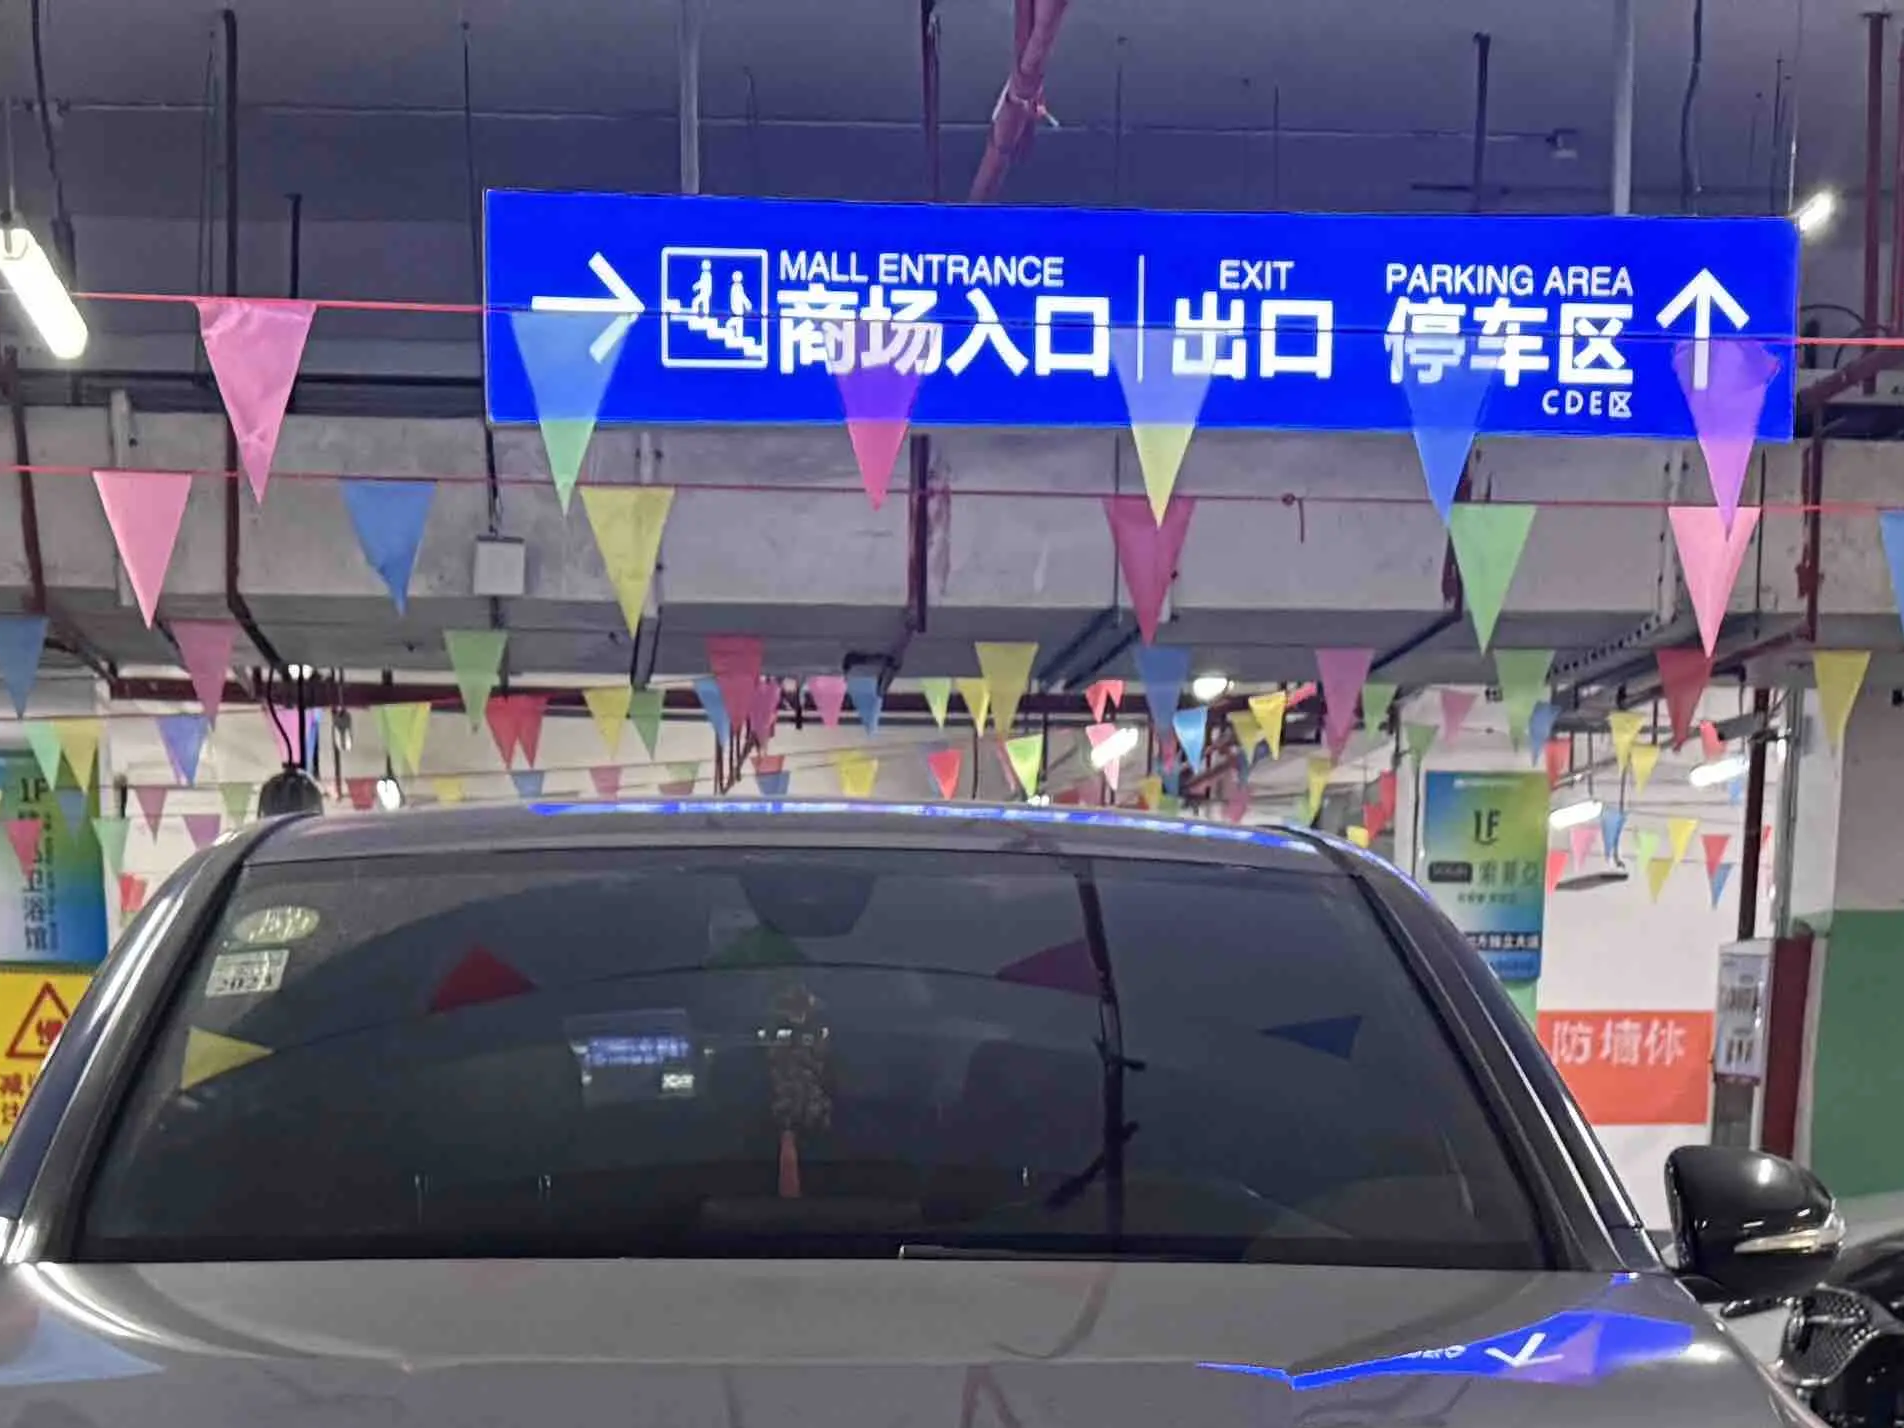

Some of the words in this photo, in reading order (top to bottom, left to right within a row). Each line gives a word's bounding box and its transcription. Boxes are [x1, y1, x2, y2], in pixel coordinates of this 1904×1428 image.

[779, 250, 868, 283] MALL
[879, 253, 1065, 288] ENTRANCE
[1219, 260, 1294, 290] EXIT
[1386, 263, 1534, 295] PARKING
[1543, 266, 1634, 297] AREA
[777, 284, 1110, 376] 商场入口
[1172, 291, 1334, 379] 出口
[1383, 297, 1634, 386] 停车区
[1551, 1018, 1687, 1067] 防墙体
